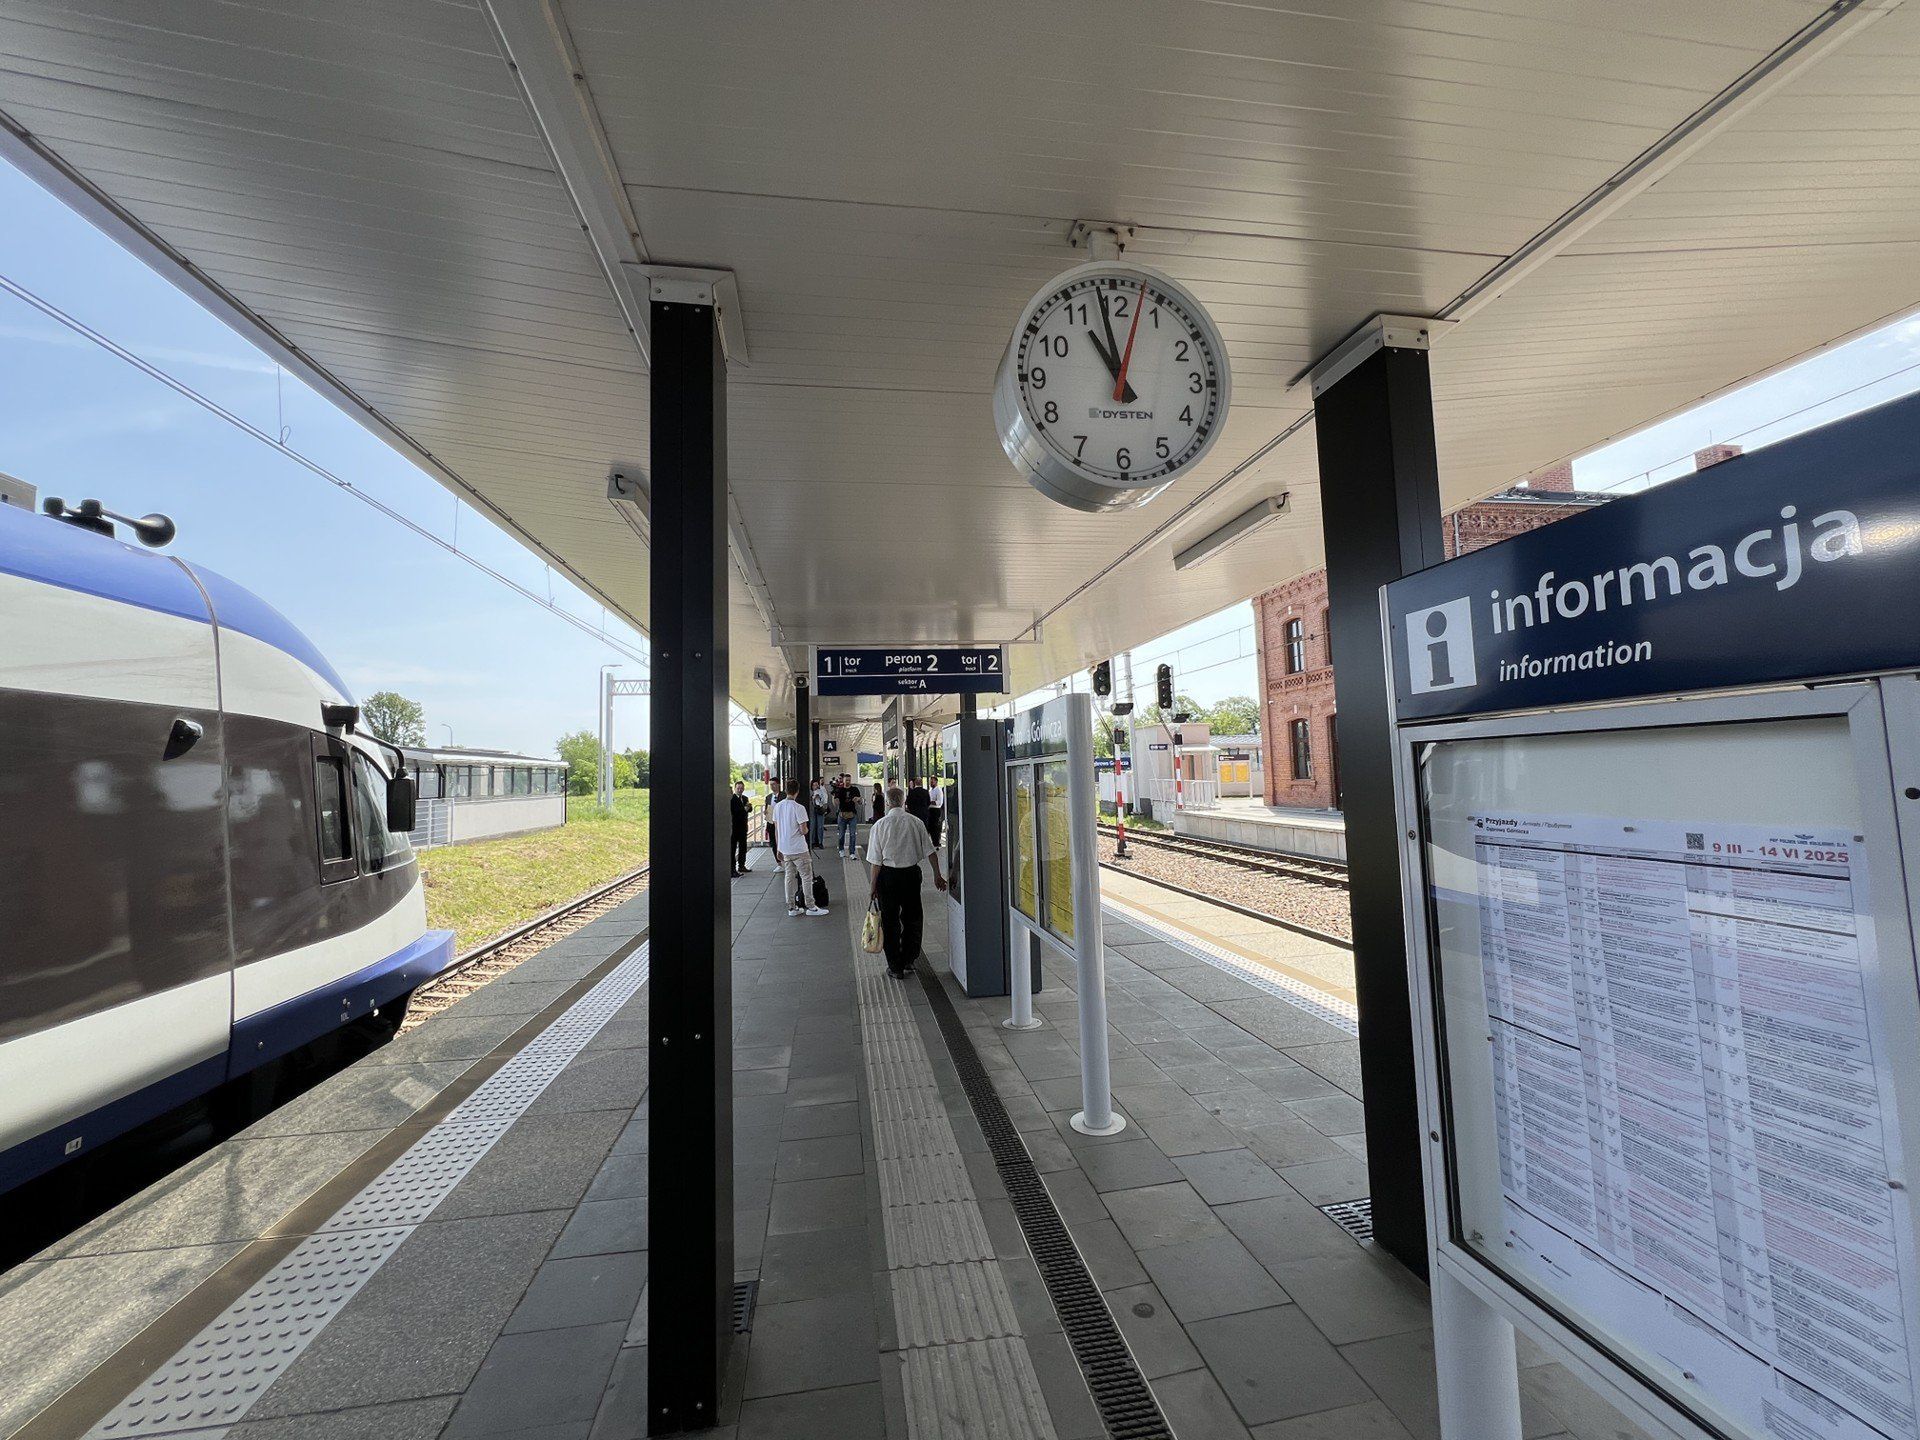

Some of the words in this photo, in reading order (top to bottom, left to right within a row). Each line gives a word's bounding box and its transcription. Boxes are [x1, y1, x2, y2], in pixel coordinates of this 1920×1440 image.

[1064, 303, 1088, 325] 11
[1149, 307, 1160, 329] 1
[1039, 335, 1069, 358] 10
[1175, 341, 1189, 362] 2
[1031, 367, 1046, 390] 9
[1188, 372, 1203, 394] 3
[1044, 401, 1059, 424] 8
[1102, 411, 1153, 420] DYSTEN
[1178, 404, 1193, 427] 4
[1073, 435, 1088, 458] 7
[1155, 437, 1170, 459] 5
[1116, 447, 1131, 470] 6
[1490, 504, 1864, 634] informacja
[824, 656, 832, 673] 1
[844, 656, 862, 666] tor
[885, 654, 922, 666] peron
[926, 654, 939, 672] 2
[961, 655, 978, 665] tor
[987, 655, 998, 671] 2
[1499, 638, 1652, 683] information
[918, 679, 927, 689] A
[1485, 817, 1518, 828] Przyjazdy
[1712, 842, 1722, 853] 9
[1726, 843, 1743, 854] III
[1759, 846, 1779, 857] 14
[1782, 847, 1799, 859] VI
[1804, 849, 1850, 863] 2025
